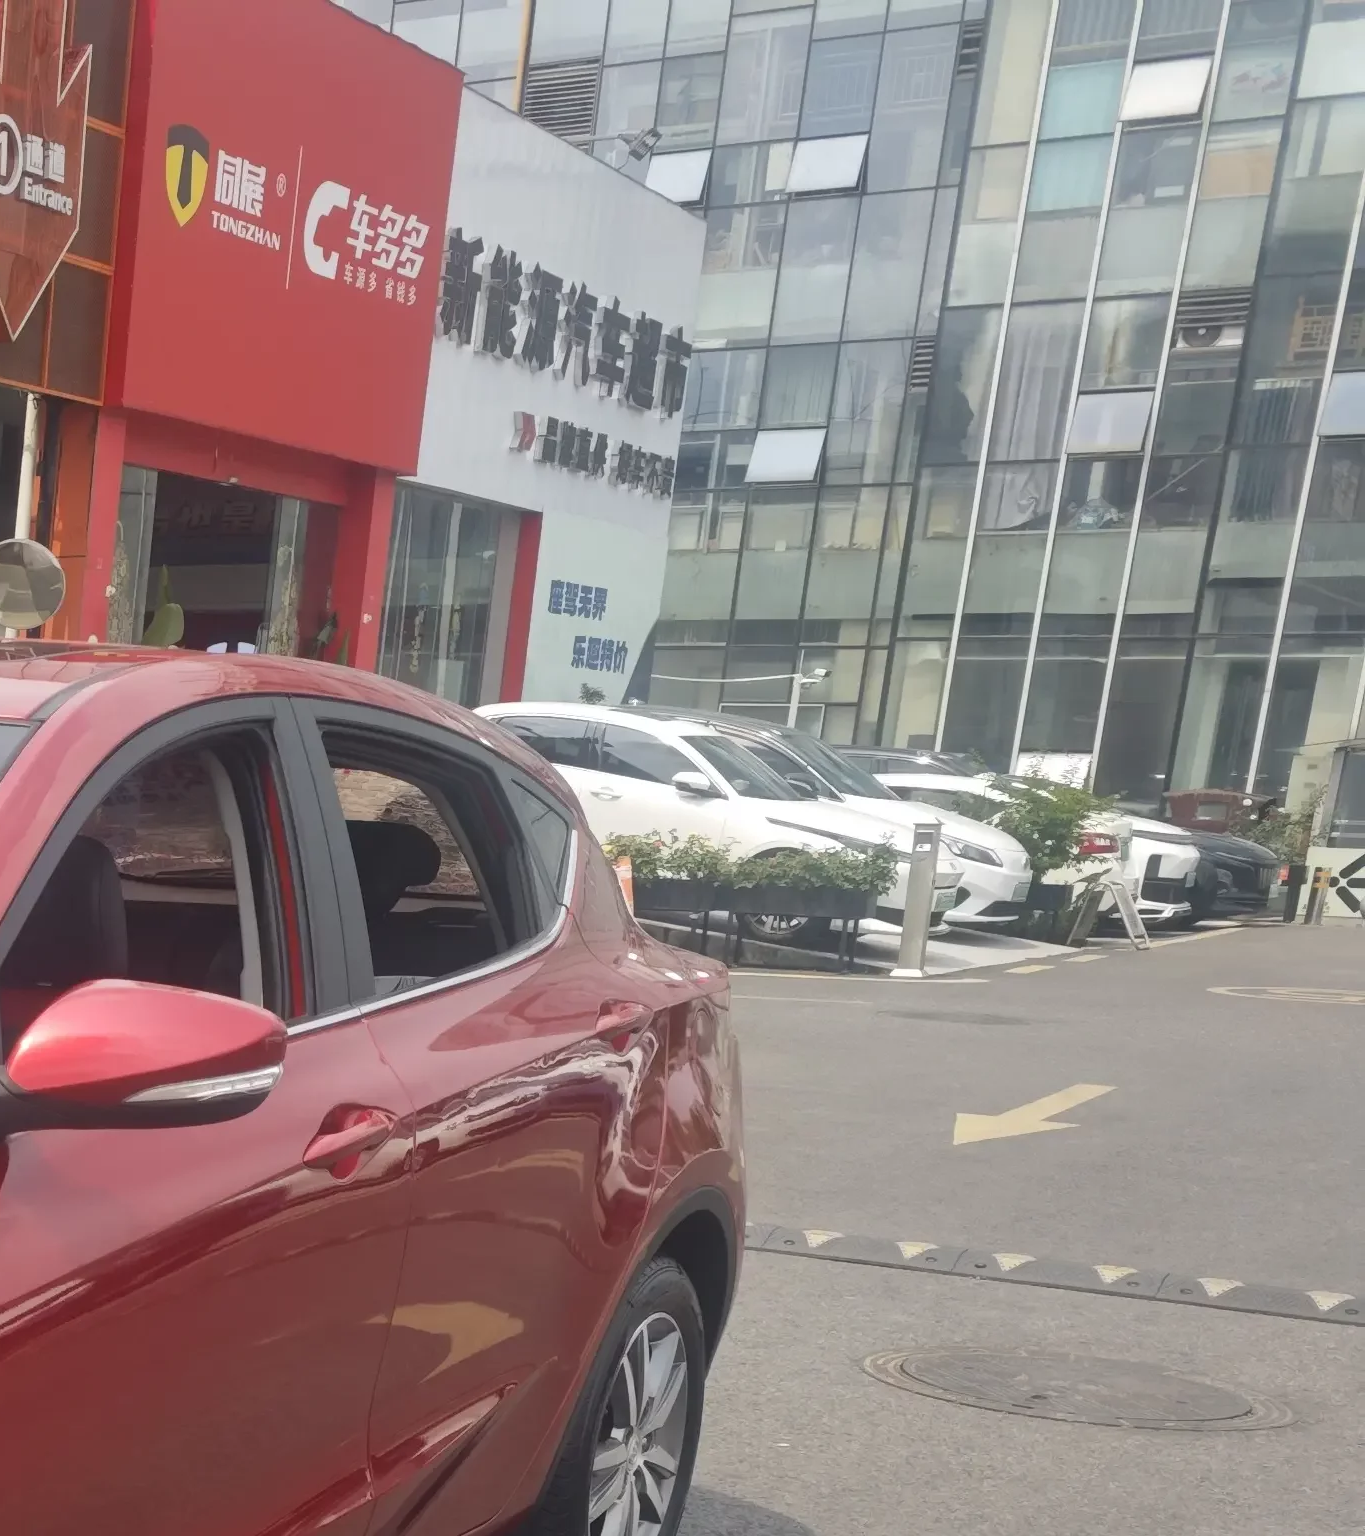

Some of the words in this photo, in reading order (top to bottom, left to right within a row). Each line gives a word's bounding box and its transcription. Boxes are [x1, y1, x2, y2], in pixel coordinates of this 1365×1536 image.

[23, 133, 66, 183] 通道
[23, 176, 73, 216] Entrance
[211, 210, 281, 251] TONGZHAN
[346, 193, 430, 279] 车多多
[343, 261, 377, 293] 车源多
[385, 277, 417, 306] 省钱多
[437, 226, 693, 418] 新能源汽车超市
